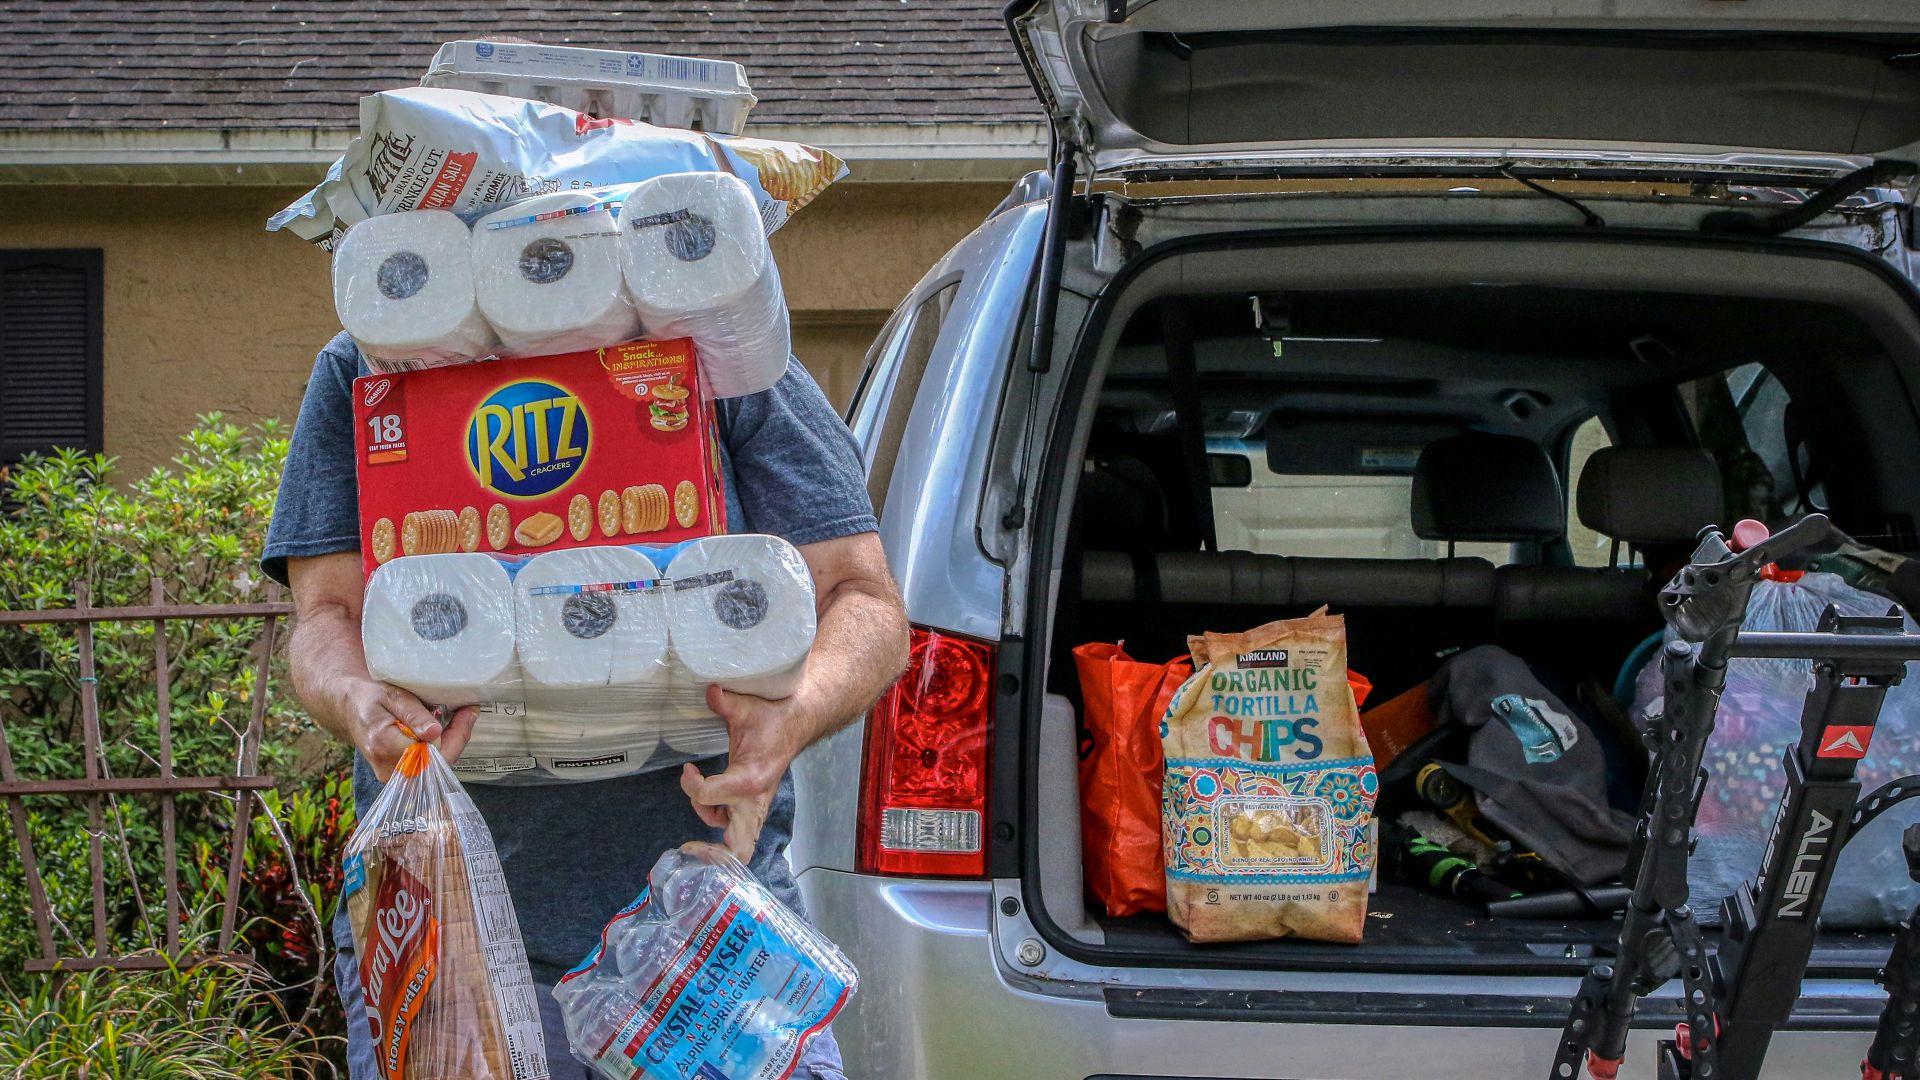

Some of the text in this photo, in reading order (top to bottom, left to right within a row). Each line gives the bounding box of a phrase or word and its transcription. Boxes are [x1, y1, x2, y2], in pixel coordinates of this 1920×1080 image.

[394, 167, 415, 196] BRAND
[442, 160, 462, 182] SALT
[483, 172, 507, 203] PROMISE
[612, 355, 685, 371] INSPIRATIONS!
[623, 349, 655, 361] Snack
[366, 381, 388, 405] NABISCO
[368, 414, 402, 444] 18
[475, 396, 582, 488] RITZ
[392, 441, 406, 449] PACKS
[530, 461, 571, 477] CRACKERS
[1240, 651, 1286, 662] KIRKLAND
[1211, 668, 1317, 692] ORGANIC
[1211, 694, 1319, 716] TORTILLA
[1208, 716, 1323, 762] CHIPS
[556, 754, 622, 768] KIRKLAND
[1777, 809, 1833, 918] ALLEN
[377, 889, 424, 967] Lee
[643, 997, 672, 1035] BOTTLED
[673, 983, 682, 995] AT
[683, 964, 698, 981] THE
[698, 927, 722, 962] SOURCE
[646, 995, 705, 1065] CRYSTAL
[696, 923, 754, 996] GEYSER
[389, 965, 430, 1073] HONEY WHEAT
[676, 948, 771, 1079] ALPINE SPRING WATER
[686, 969, 743, 1043] NATURAL
[721, 1033, 728, 1042] BY
[734, 1002, 751, 1025] ROXANE
[508, 1034, 522, 1080] Nutrition
[517, 1051, 527, 1080] Facts
[775, 1049, 783, 1058] OZ
[780, 1056, 789, 1064] OZ
